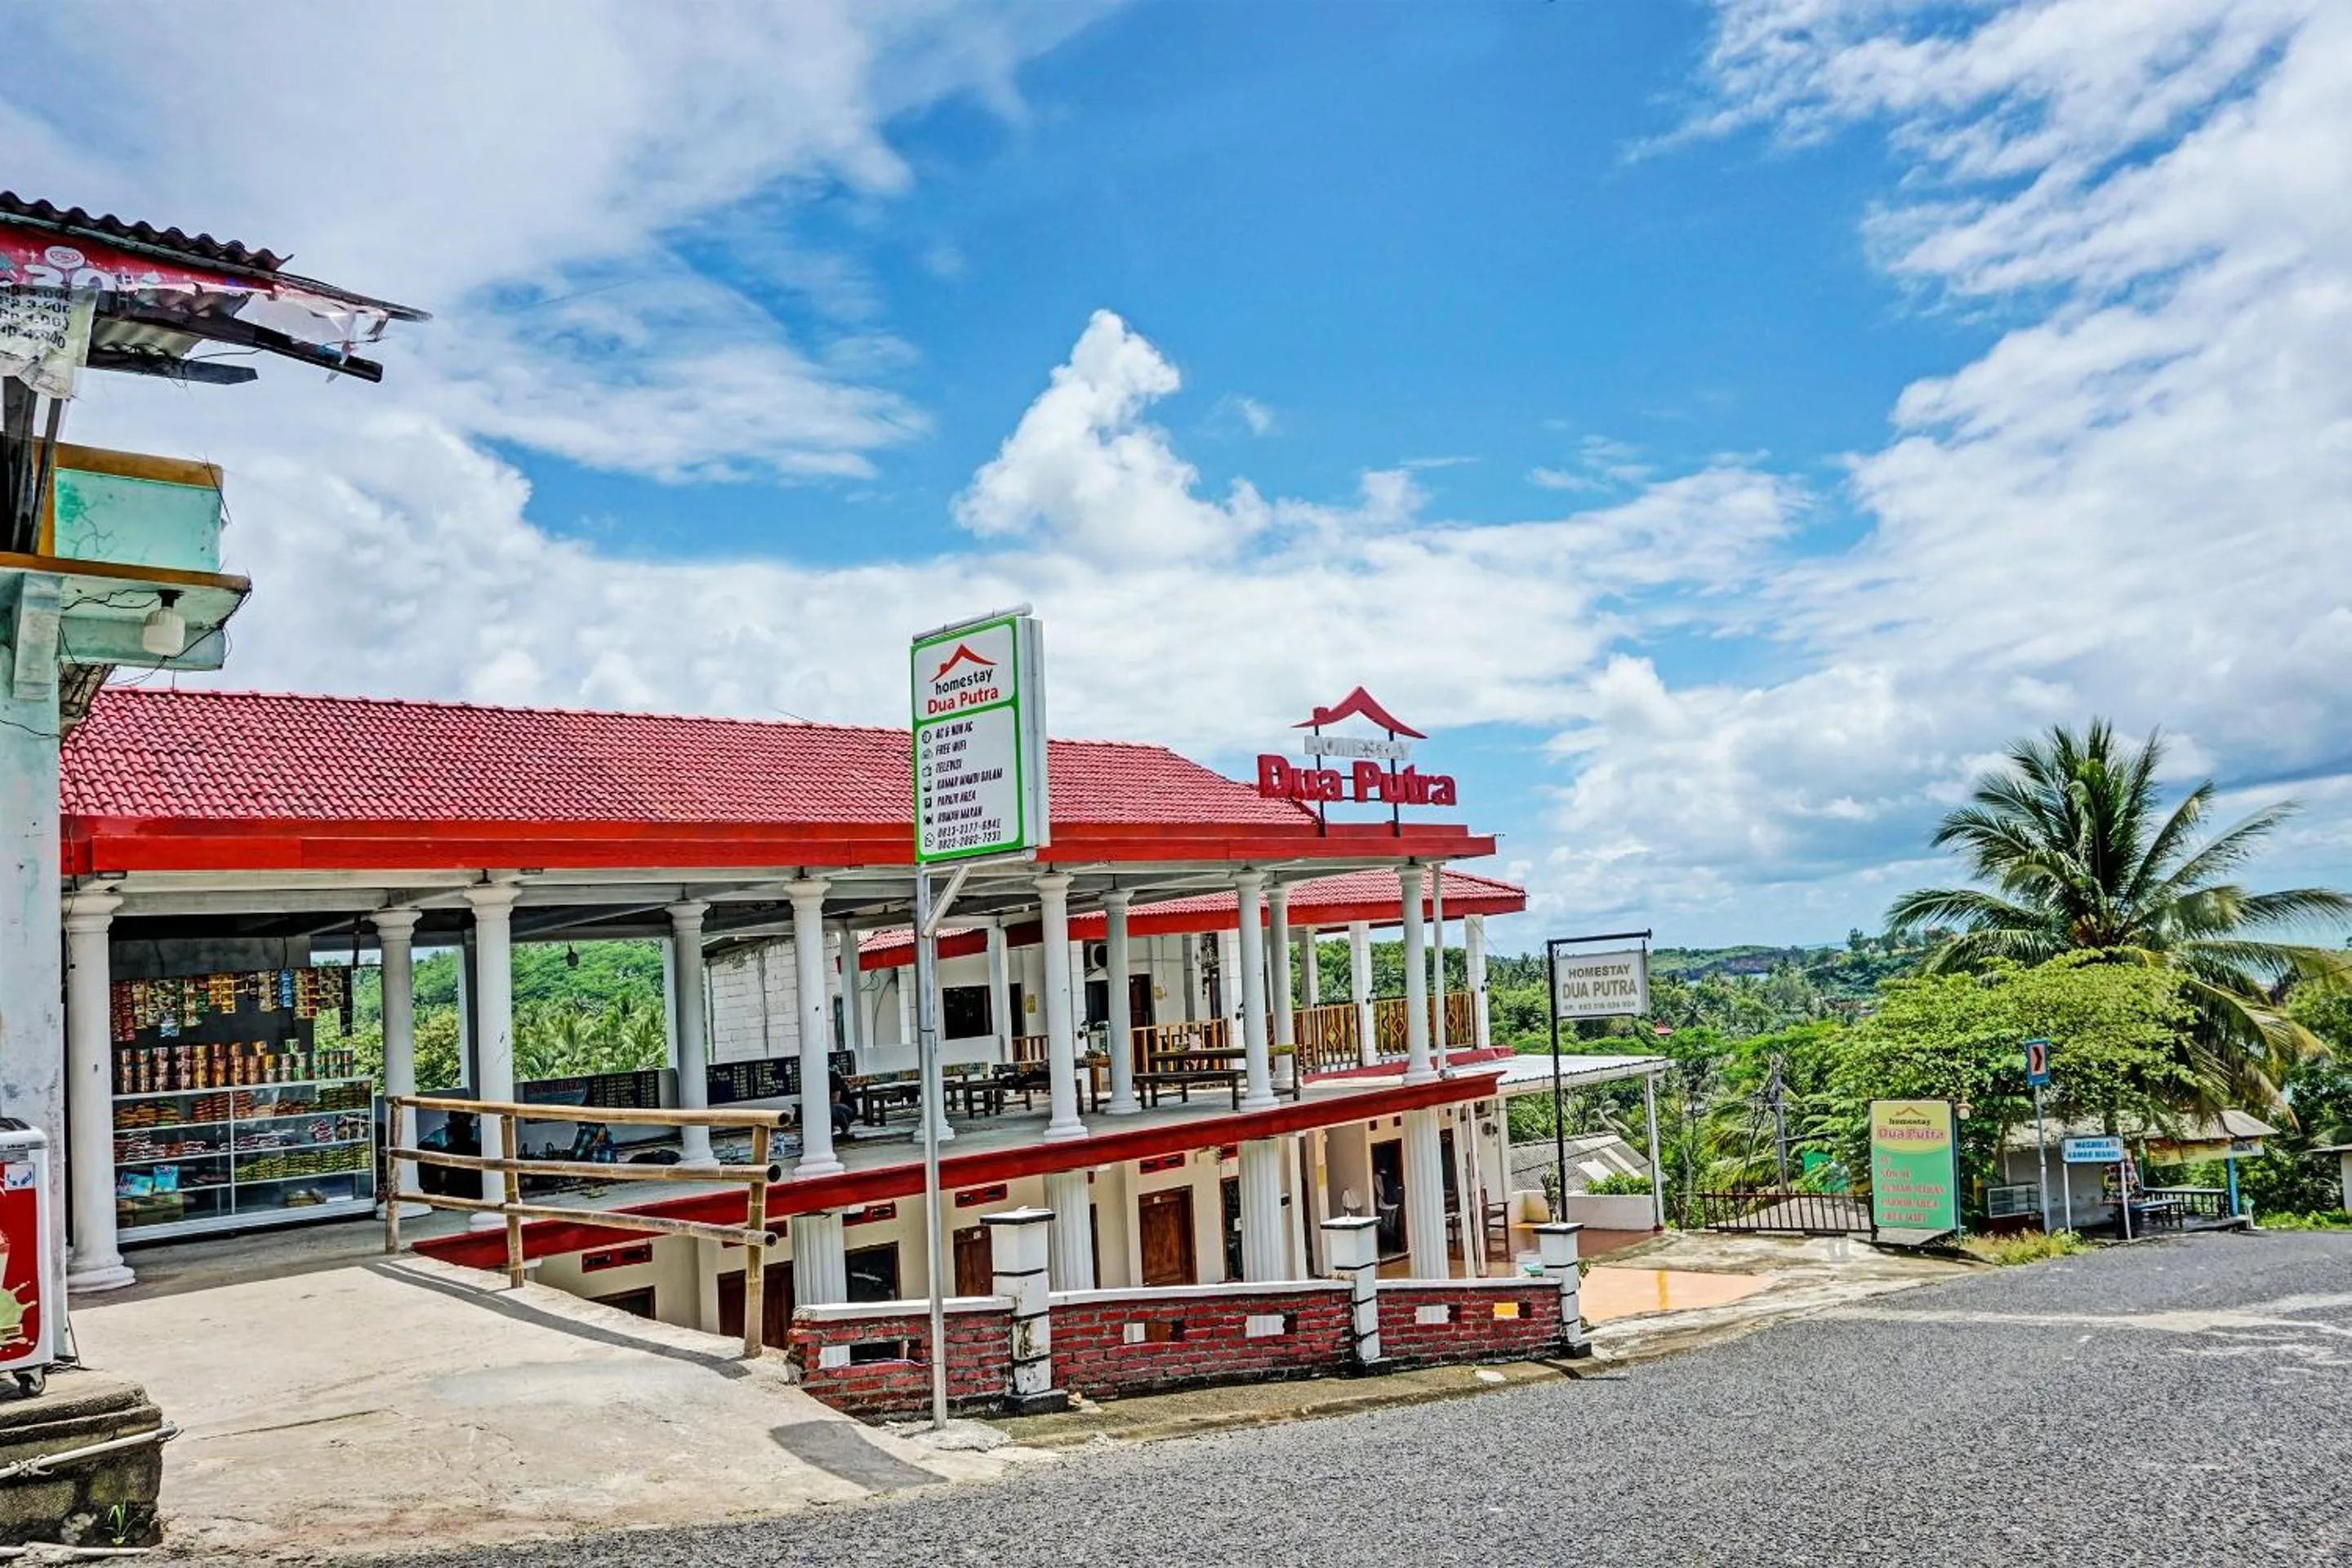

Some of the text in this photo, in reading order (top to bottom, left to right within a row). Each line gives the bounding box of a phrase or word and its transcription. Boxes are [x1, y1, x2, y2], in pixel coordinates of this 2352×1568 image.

[935, 668, 993, 695] homestay
[928, 687, 998, 715] Dua Putra
[1258, 754, 1457, 806] Dua Putra
[1568, 964, 1630, 978] HOMESTAY
[1562, 978, 1637, 999] DUA PUTRA
[1889, 1118, 1931, 1126] homestay
[1879, 1128, 1944, 1140] Dua Putra
